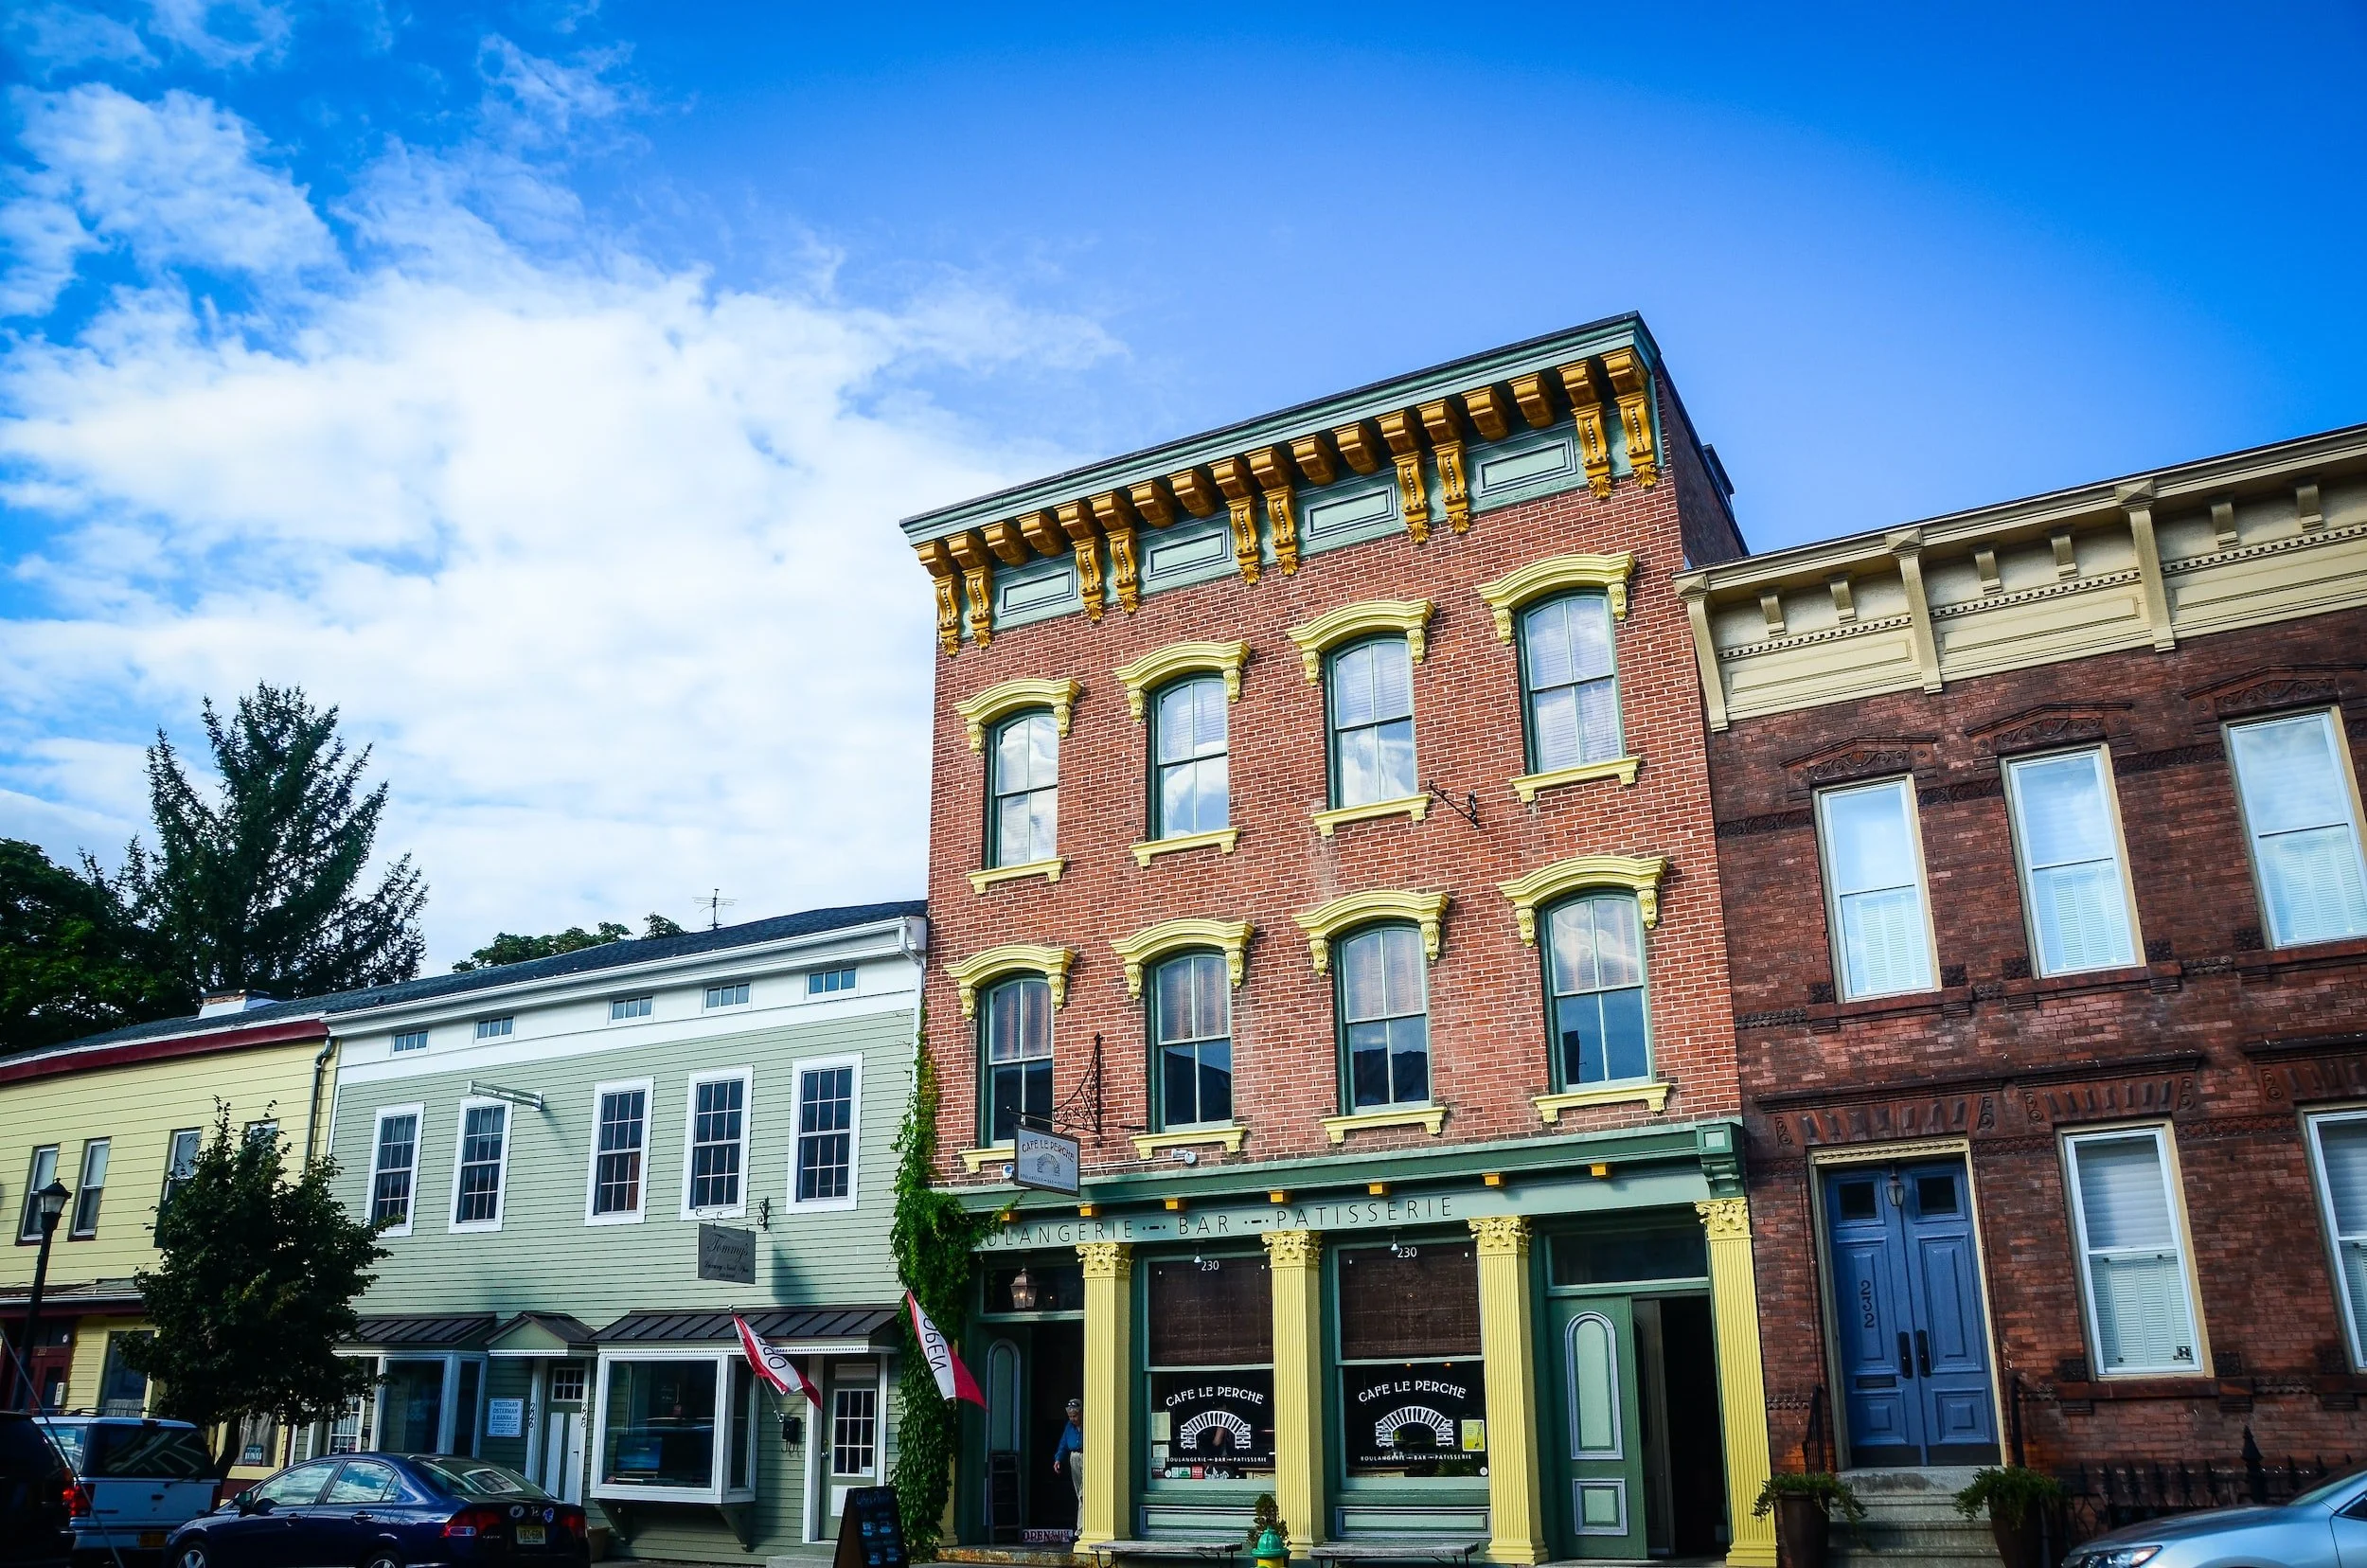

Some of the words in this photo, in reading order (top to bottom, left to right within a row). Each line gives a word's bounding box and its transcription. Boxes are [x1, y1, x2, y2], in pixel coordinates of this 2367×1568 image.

[1022, 1139, 1039, 1153] CAFE
[1040, 1139, 1049, 1149] LE
[1050, 1141, 1075, 1163] PERCHE
[971, 1221, 1132, 1247] ULANGERIE
[1178, 1215, 1229, 1235] BAR
[1277, 1197, 1452, 1229] PATISSERIE
[706, 1233, 749, 1262] Tommy's
[1397, 1247, 1417, 1258] 230
[1201, 1260, 1219, 1272] 230
[1860, 1279, 1875, 1328] 232
[1166, 1389, 1195, 1407] CAFE
[1198, 1386, 1214, 1398] LE
[1217, 1386, 1264, 1405] PERCHE
[1358, 1383, 1391, 1402] CAFE
[1394, 1381, 1411, 1393] LE
[1415, 1380, 1467, 1399] PERCHE
